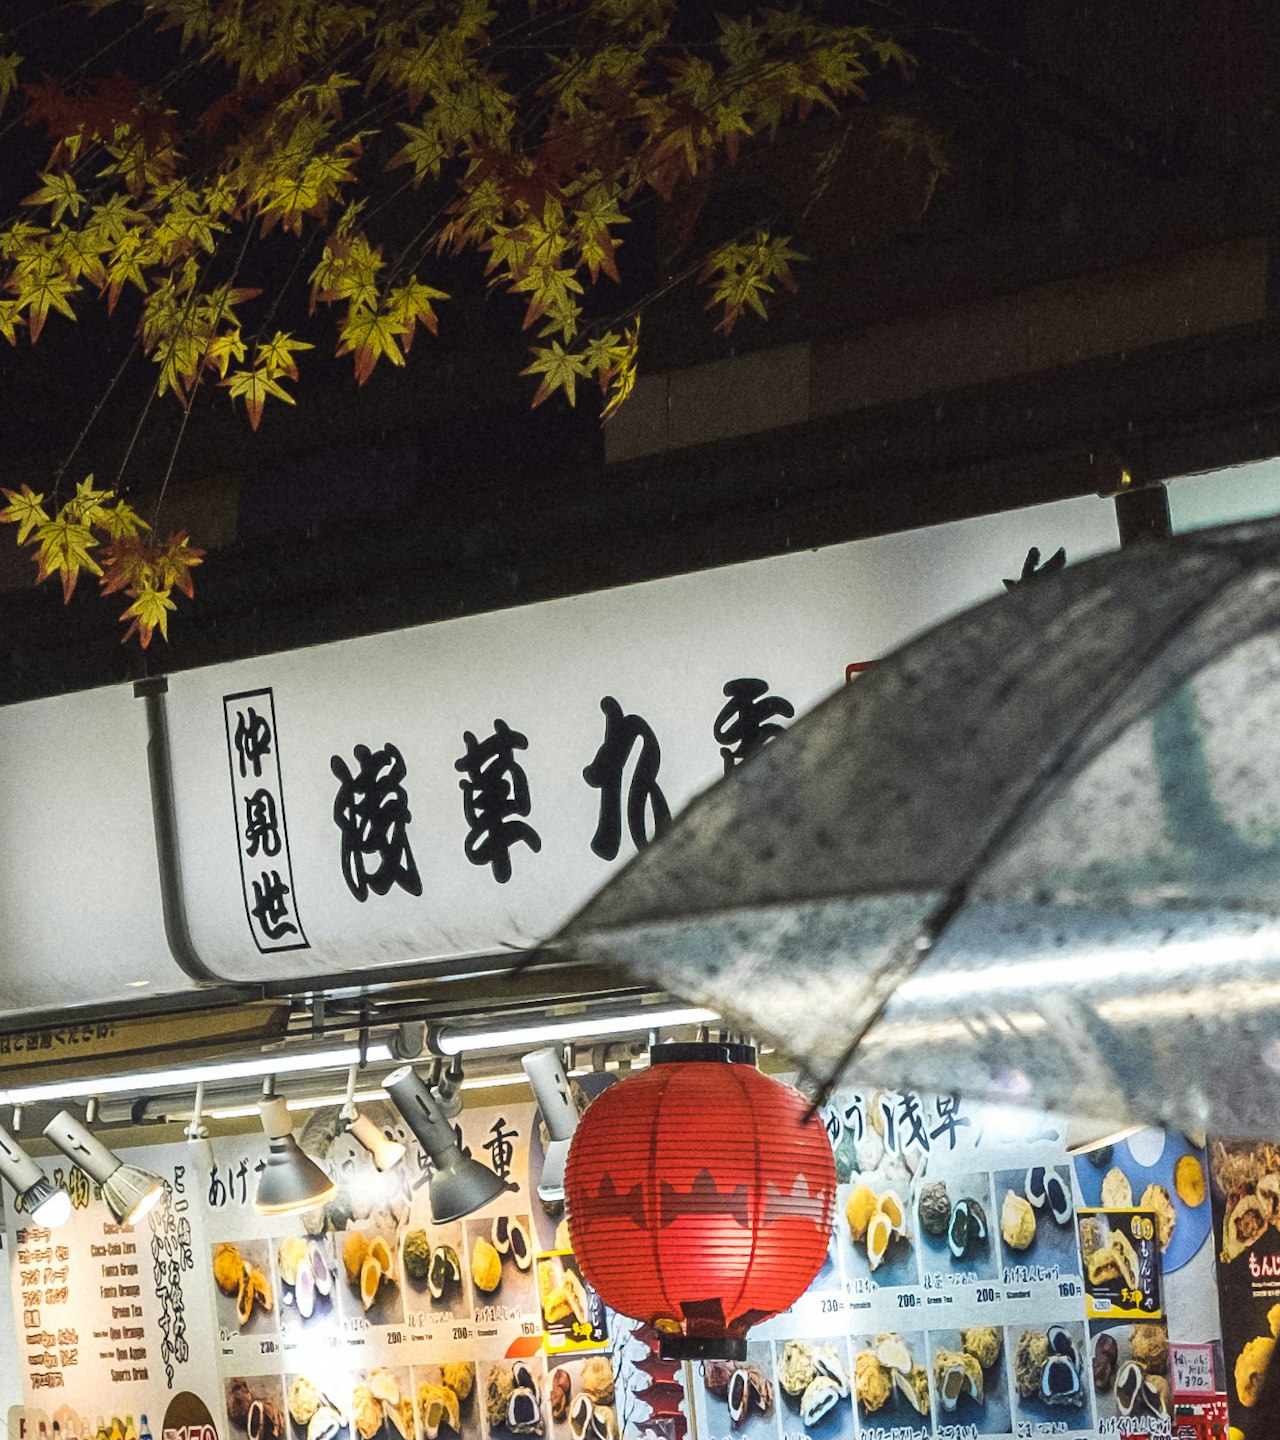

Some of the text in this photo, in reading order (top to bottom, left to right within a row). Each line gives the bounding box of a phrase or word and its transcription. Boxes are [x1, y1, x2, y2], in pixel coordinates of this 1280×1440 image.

[234, 706, 299, 940] 仲見世
[1141, 1240, 1153, 1309] もんじゃ
